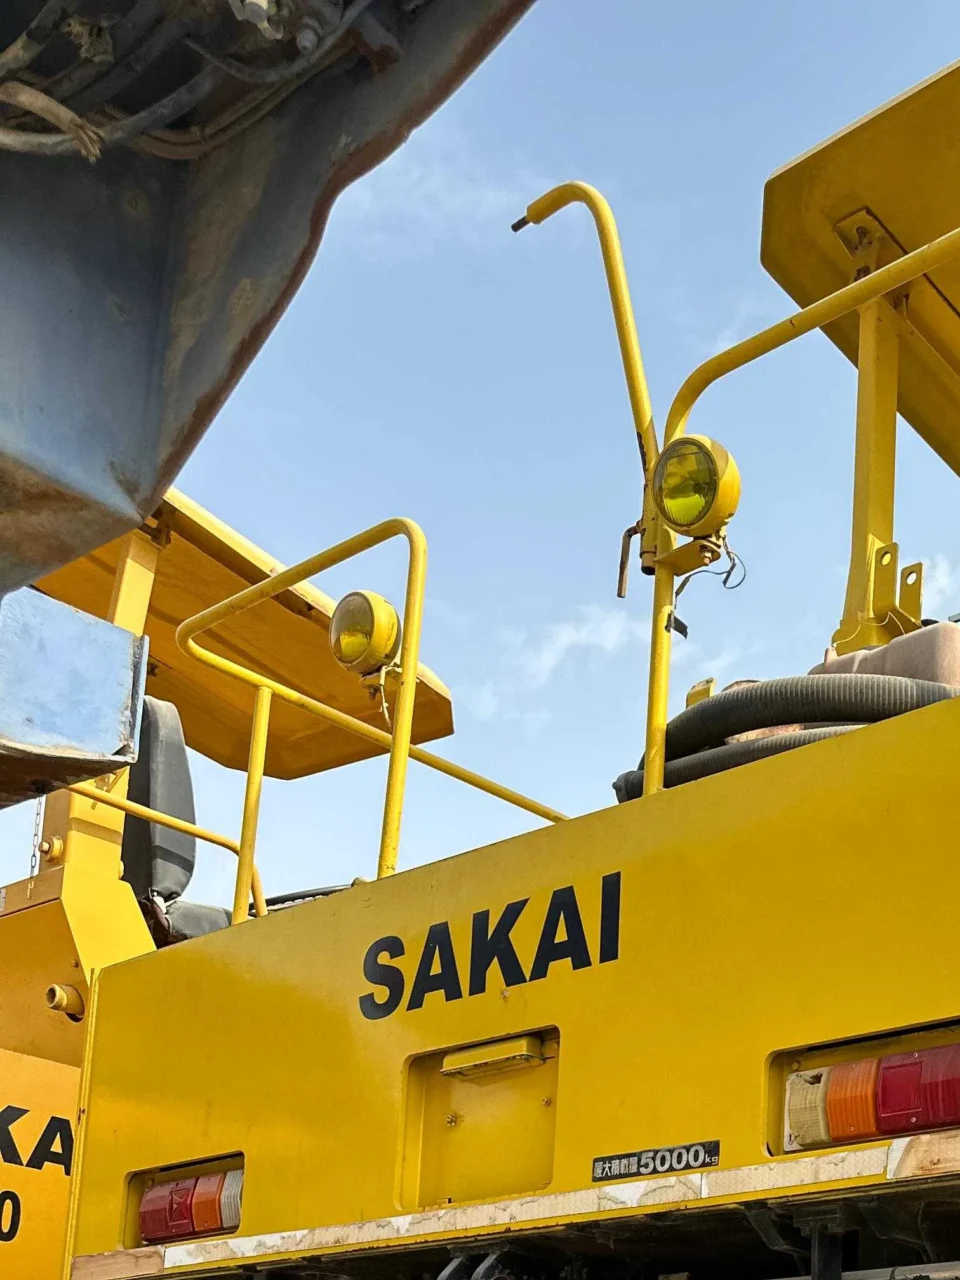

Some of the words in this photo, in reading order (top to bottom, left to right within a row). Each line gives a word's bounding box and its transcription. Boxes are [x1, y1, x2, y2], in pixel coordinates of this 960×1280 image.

[358, 871, 621, 1020] SAKAI
[594, 1157, 638, 1177] 最大積載量
